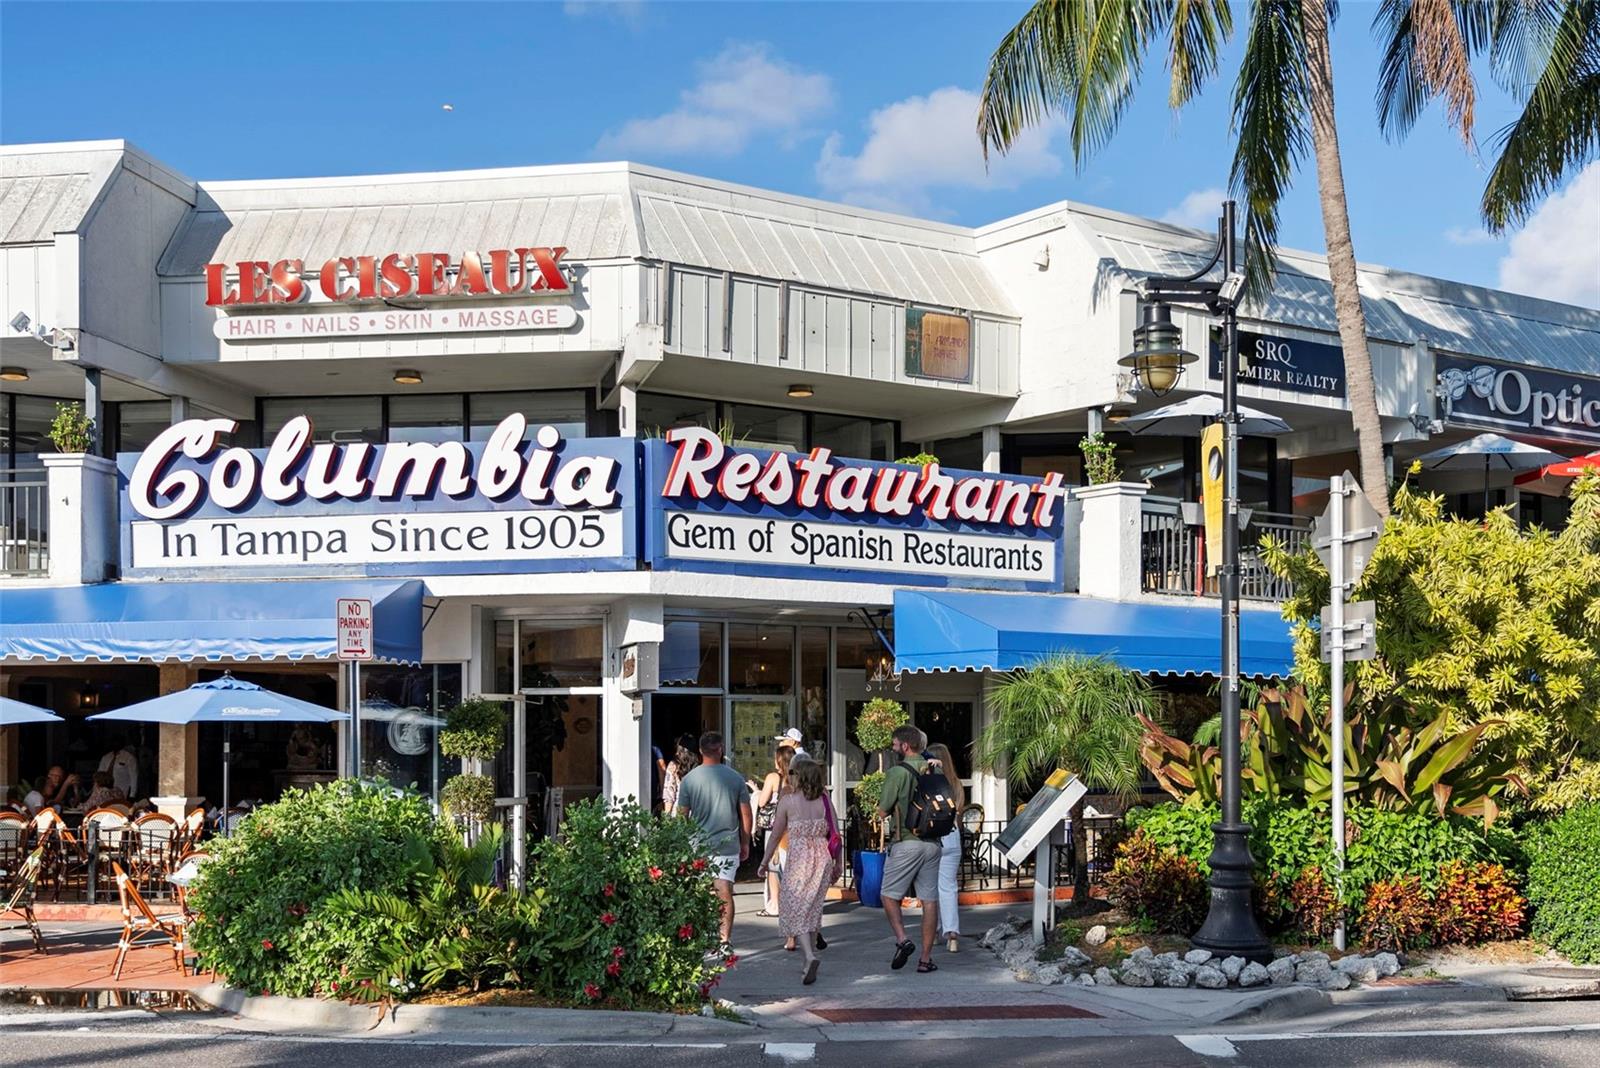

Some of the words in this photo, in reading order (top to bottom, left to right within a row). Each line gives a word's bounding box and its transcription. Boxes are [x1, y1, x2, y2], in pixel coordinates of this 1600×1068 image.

[203, 258, 305, 307] LES
[320, 247, 570, 303] CISEAUX
[229, 318, 276, 336] HAIR
[301, 315, 361, 333] NAILS
[384, 312, 433, 331] SKIN
[458, 308, 558, 328] MASSAGE
[1255, 339, 1297, 369] SRQ
[1286, 370, 1338, 391] REALTY
[128, 411, 619, 520] Columbia
[661, 425, 1066, 528] Restaurant
[161, 524, 198, 558] In
[211, 522, 348, 562] Tampa
[371, 518, 490, 553] Since
[504, 514, 606, 551] 1905
[667, 513, 736, 551] Gem
[748, 520, 776, 554] of
[790, 522, 894, 565] Spanish
[903, 532, 1043, 572] Restaurants
[340, 616, 370, 630] PARKING
[347, 603, 362, 616] NO
[346, 638, 363, 647] TIME
[347, 629, 363, 638] ANY
